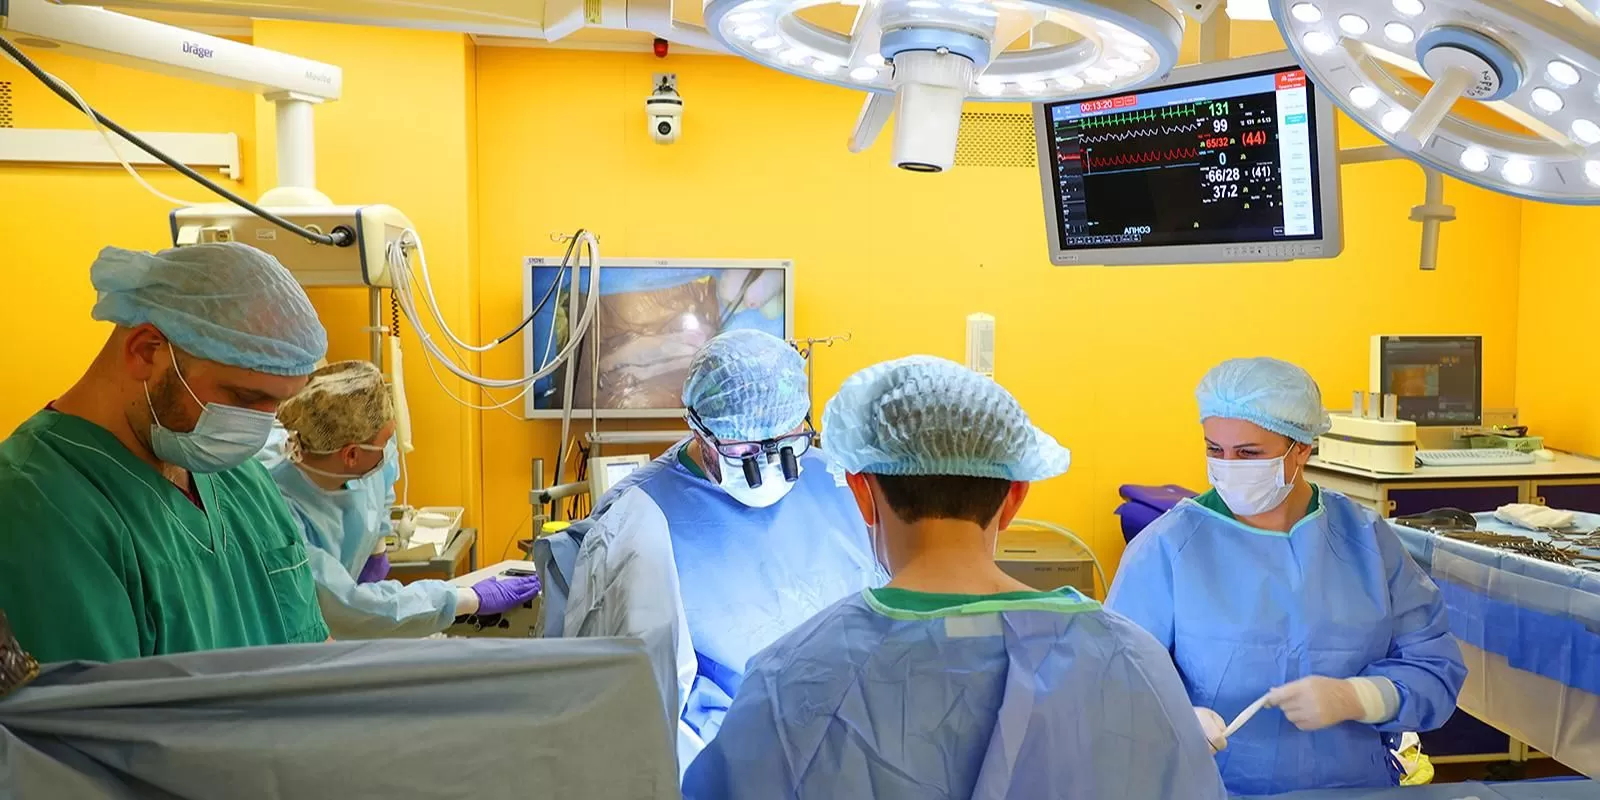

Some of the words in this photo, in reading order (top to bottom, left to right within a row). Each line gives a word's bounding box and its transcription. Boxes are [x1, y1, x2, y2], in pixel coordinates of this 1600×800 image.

[182, 41, 214, 58] Dräger
[1081, 100, 1113, 112] 00:13:20
[1209, 101, 1230, 117] 131
[1213, 119, 1228, 133] 99
[1206, 138, 1229, 149] 65/32
[1242, 131, 1267, 147] (44)
[1219, 152, 1227, 166] 0
[1209, 168, 1240, 183] 66/28
[1252, 166, 1271, 178] (41)
[1124, 225, 1151, 234] АПНОЭ
